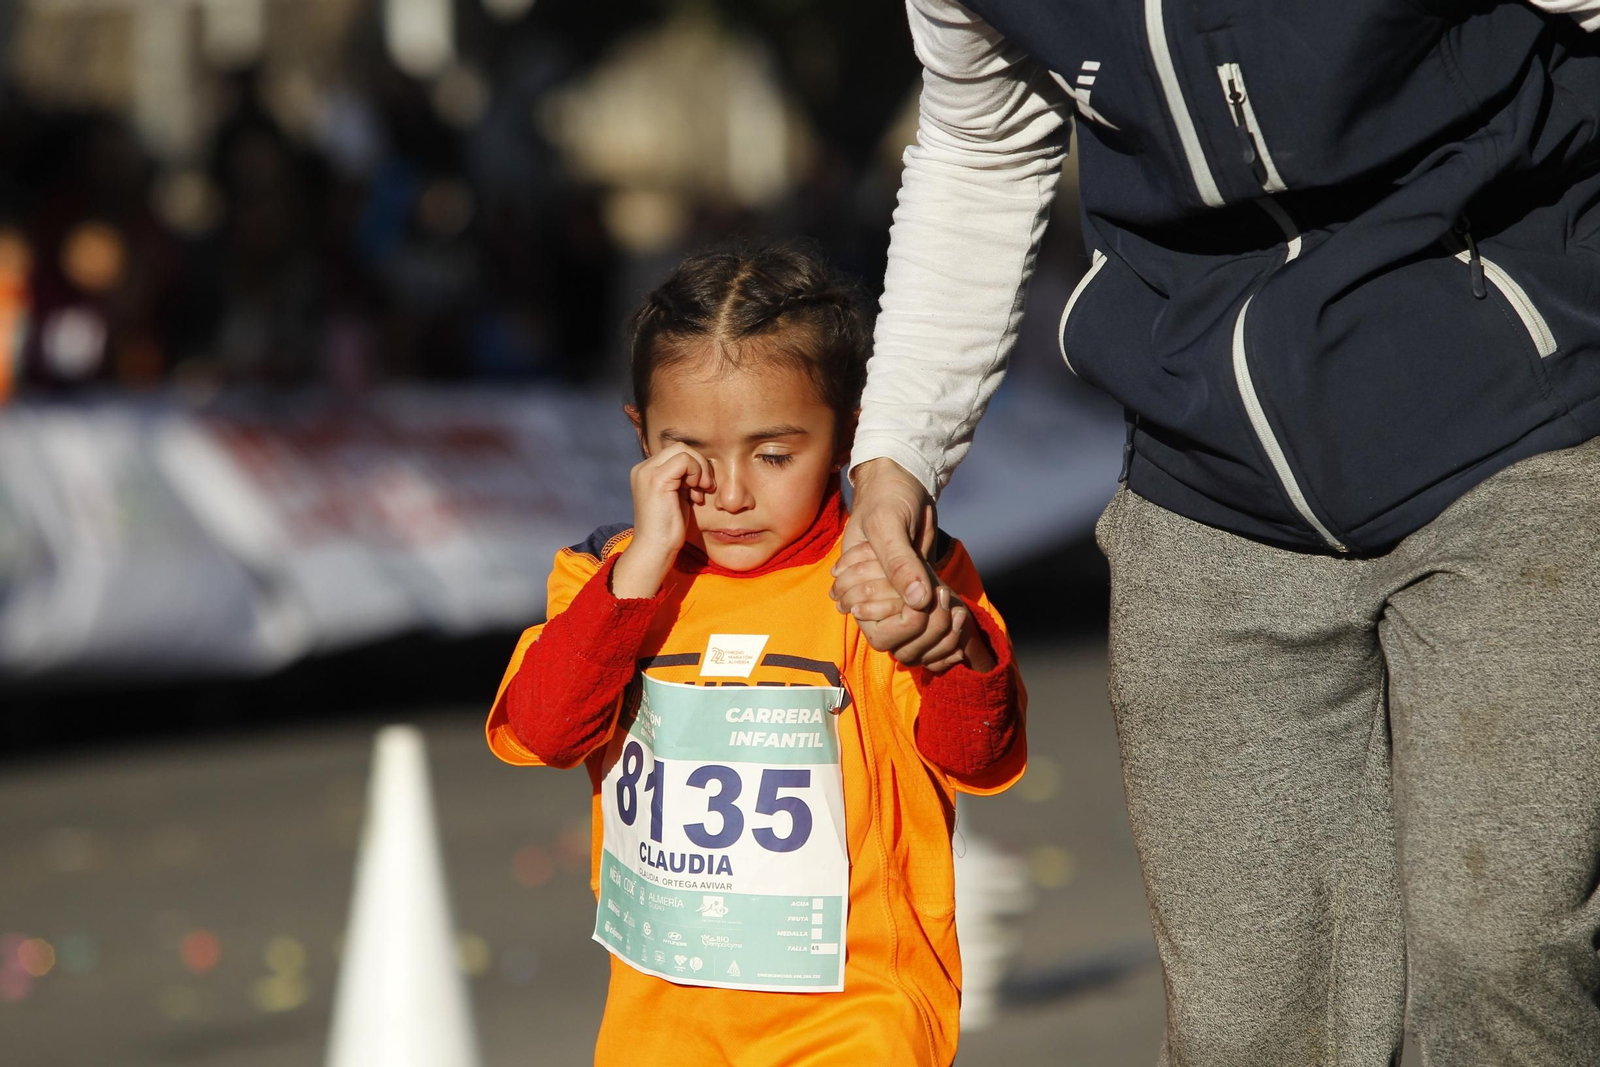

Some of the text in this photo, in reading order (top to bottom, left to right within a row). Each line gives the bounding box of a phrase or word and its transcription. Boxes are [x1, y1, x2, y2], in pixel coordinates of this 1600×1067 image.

[725, 707, 823, 724] CARRERA
[729, 731, 824, 748] INFANTIL
[616, 740, 813, 853] 8135
[639, 841, 733, 876] CLAUDIA
[662, 878, 698, 889] ORTEGA
[699, 881, 733, 891] AVIVAR
[648, 892, 684, 908] ALMERÍA
